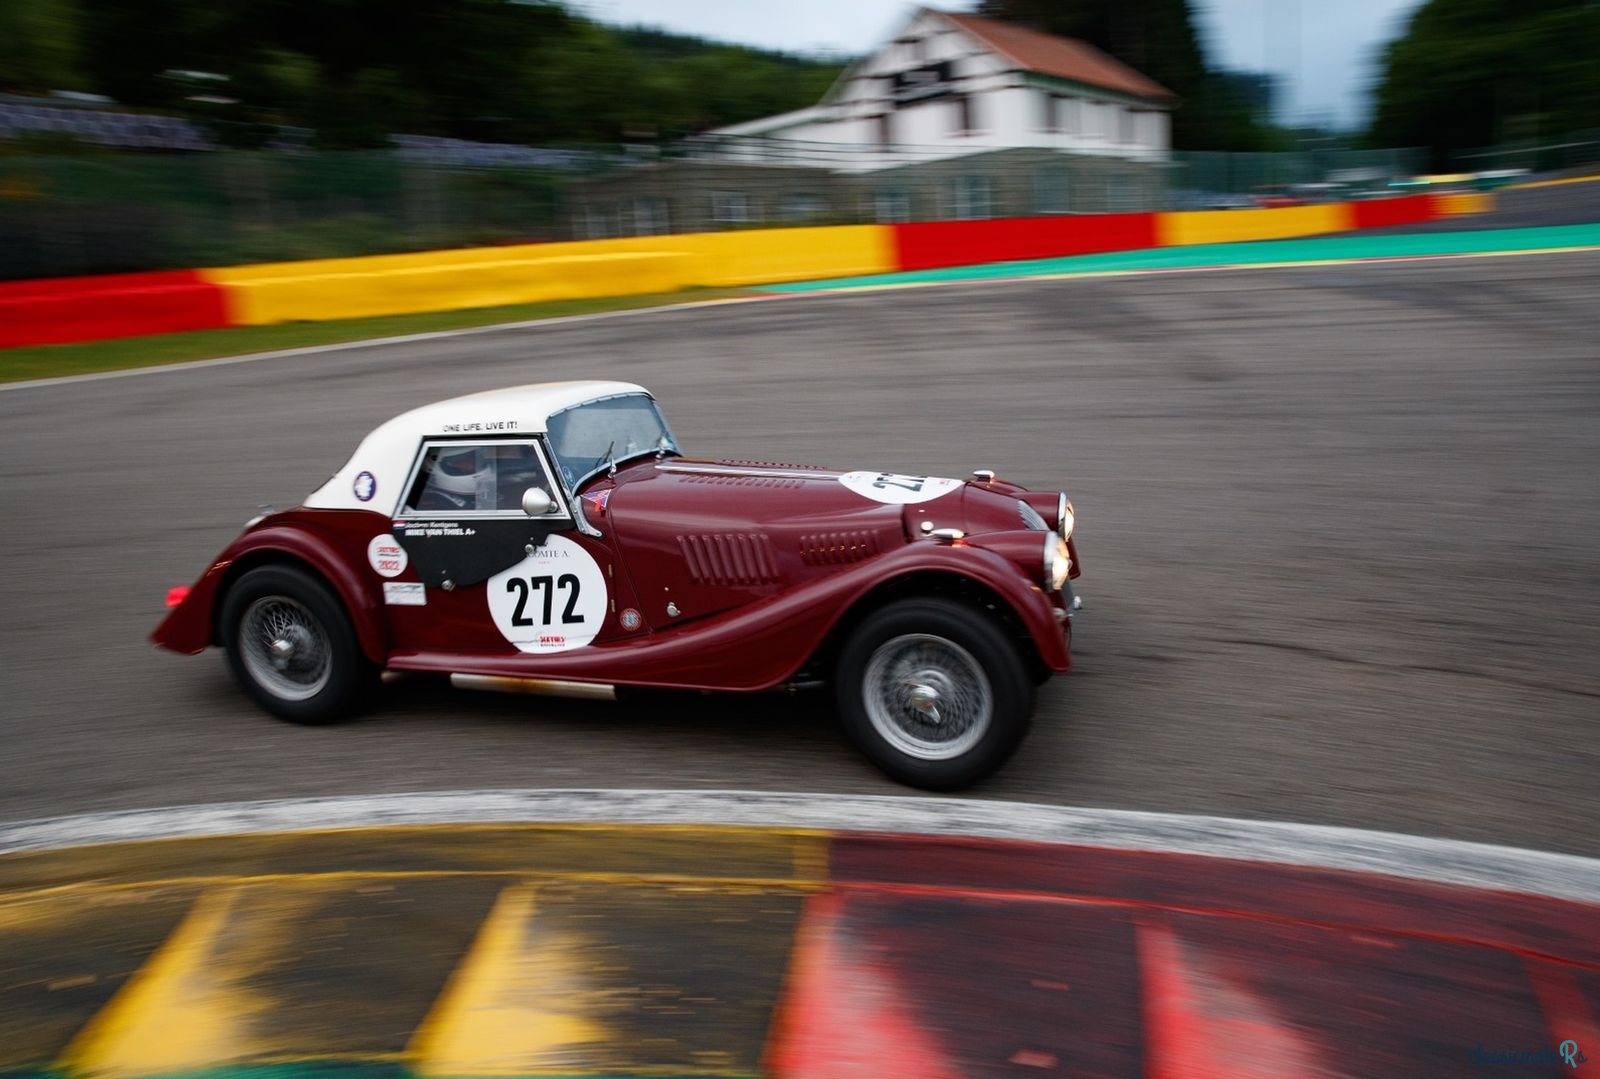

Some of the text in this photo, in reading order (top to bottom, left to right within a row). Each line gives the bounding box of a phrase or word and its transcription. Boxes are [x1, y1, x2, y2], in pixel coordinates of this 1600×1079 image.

[442, 424, 460, 433] ONE
[486, 421, 504, 430] LIVE
[506, 420, 518, 429] IT!
[425, 528, 443, 537] VAN
[443, 528, 465, 536] THIEL
[506, 573, 585, 627] 272
